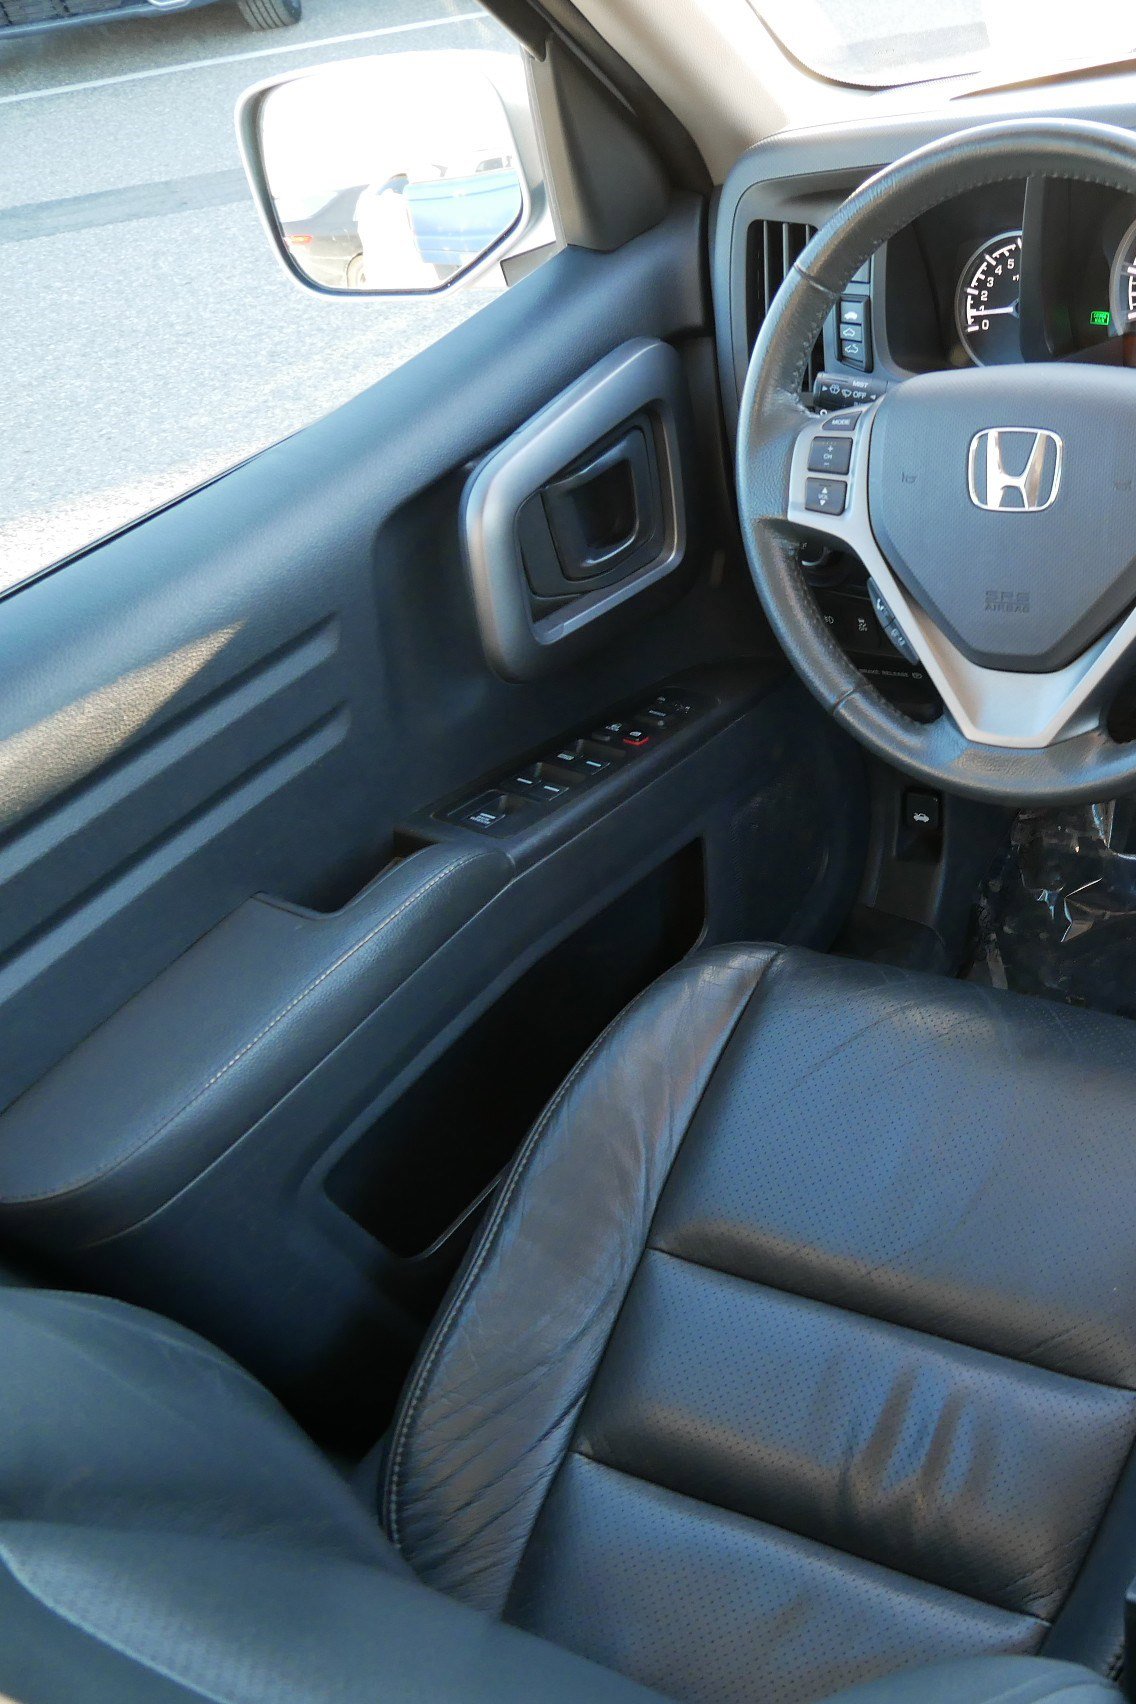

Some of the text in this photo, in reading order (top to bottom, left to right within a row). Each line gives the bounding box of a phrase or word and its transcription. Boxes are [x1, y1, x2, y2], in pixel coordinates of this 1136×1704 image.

[1007, 258, 1015, 269] 5
[994, 264, 1003, 276] 4
[986, 276, 994, 287] 3
[980, 290, 988, 301] 2
[981, 319, 990, 330] 0
[853, 390, 867, 399] OFF
